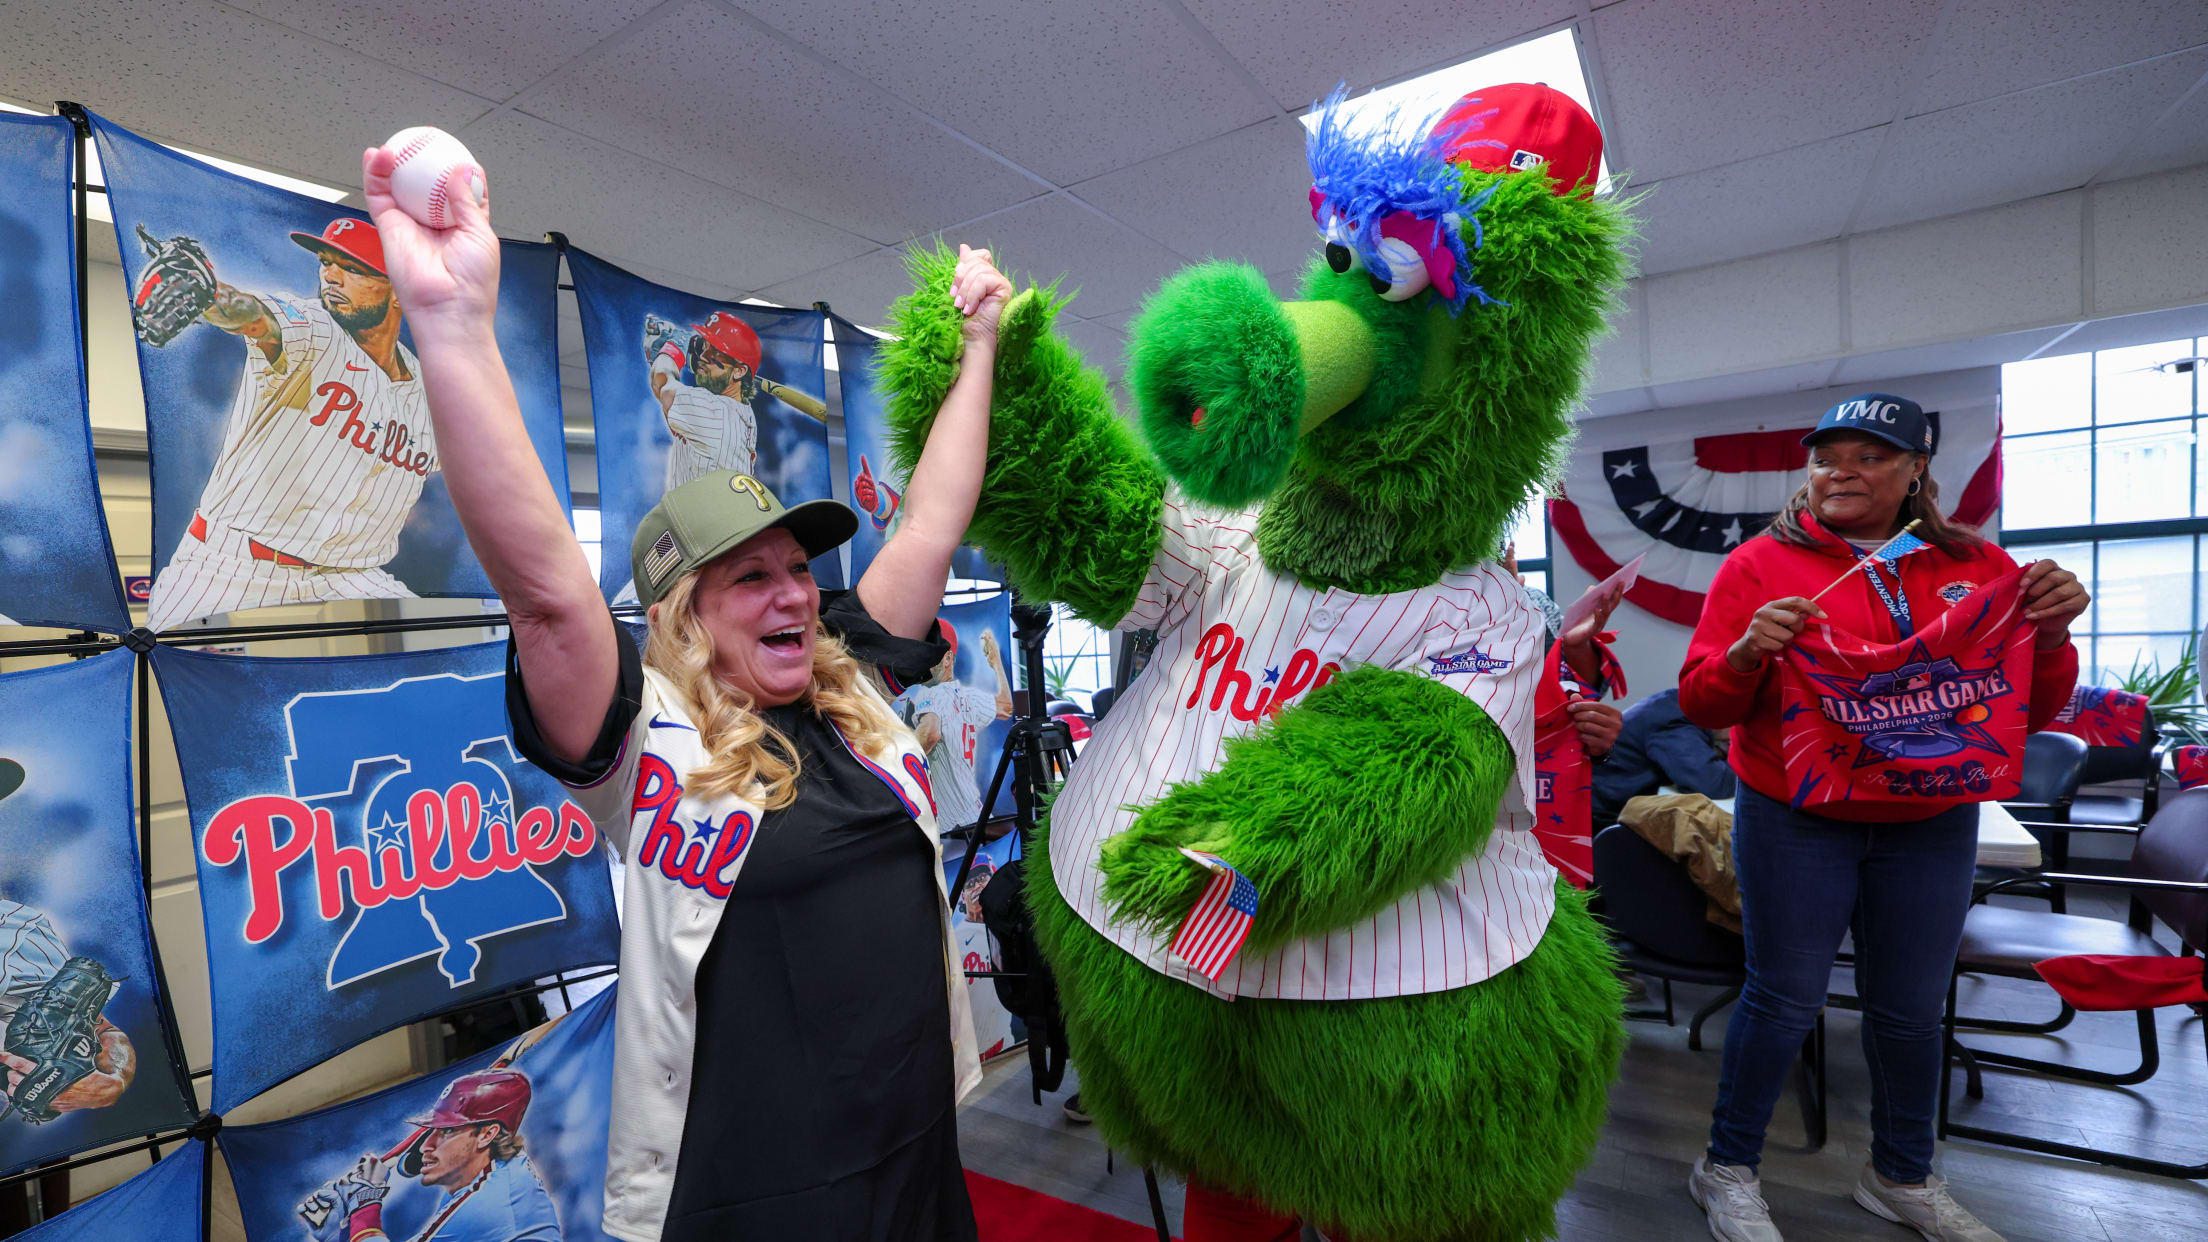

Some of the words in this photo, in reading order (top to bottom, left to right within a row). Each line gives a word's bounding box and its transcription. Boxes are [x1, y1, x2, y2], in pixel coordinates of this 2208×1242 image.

[333, 218, 355, 235] P
[1835, 399, 1900, 424] VMC
[729, 474, 771, 512] P
[1452, 660, 1477, 670] STAR
[1477, 659, 1505, 669] GAME
[1938, 669, 2008, 708] GAME
[1848, 717, 1920, 732] PHILADELPHIA
[1928, 711, 1953, 723] 2026
[202, 781, 597, 945] Phillies
[73, 1037, 91, 1057] W
[24, 1067, 61, 1101] Wilson
